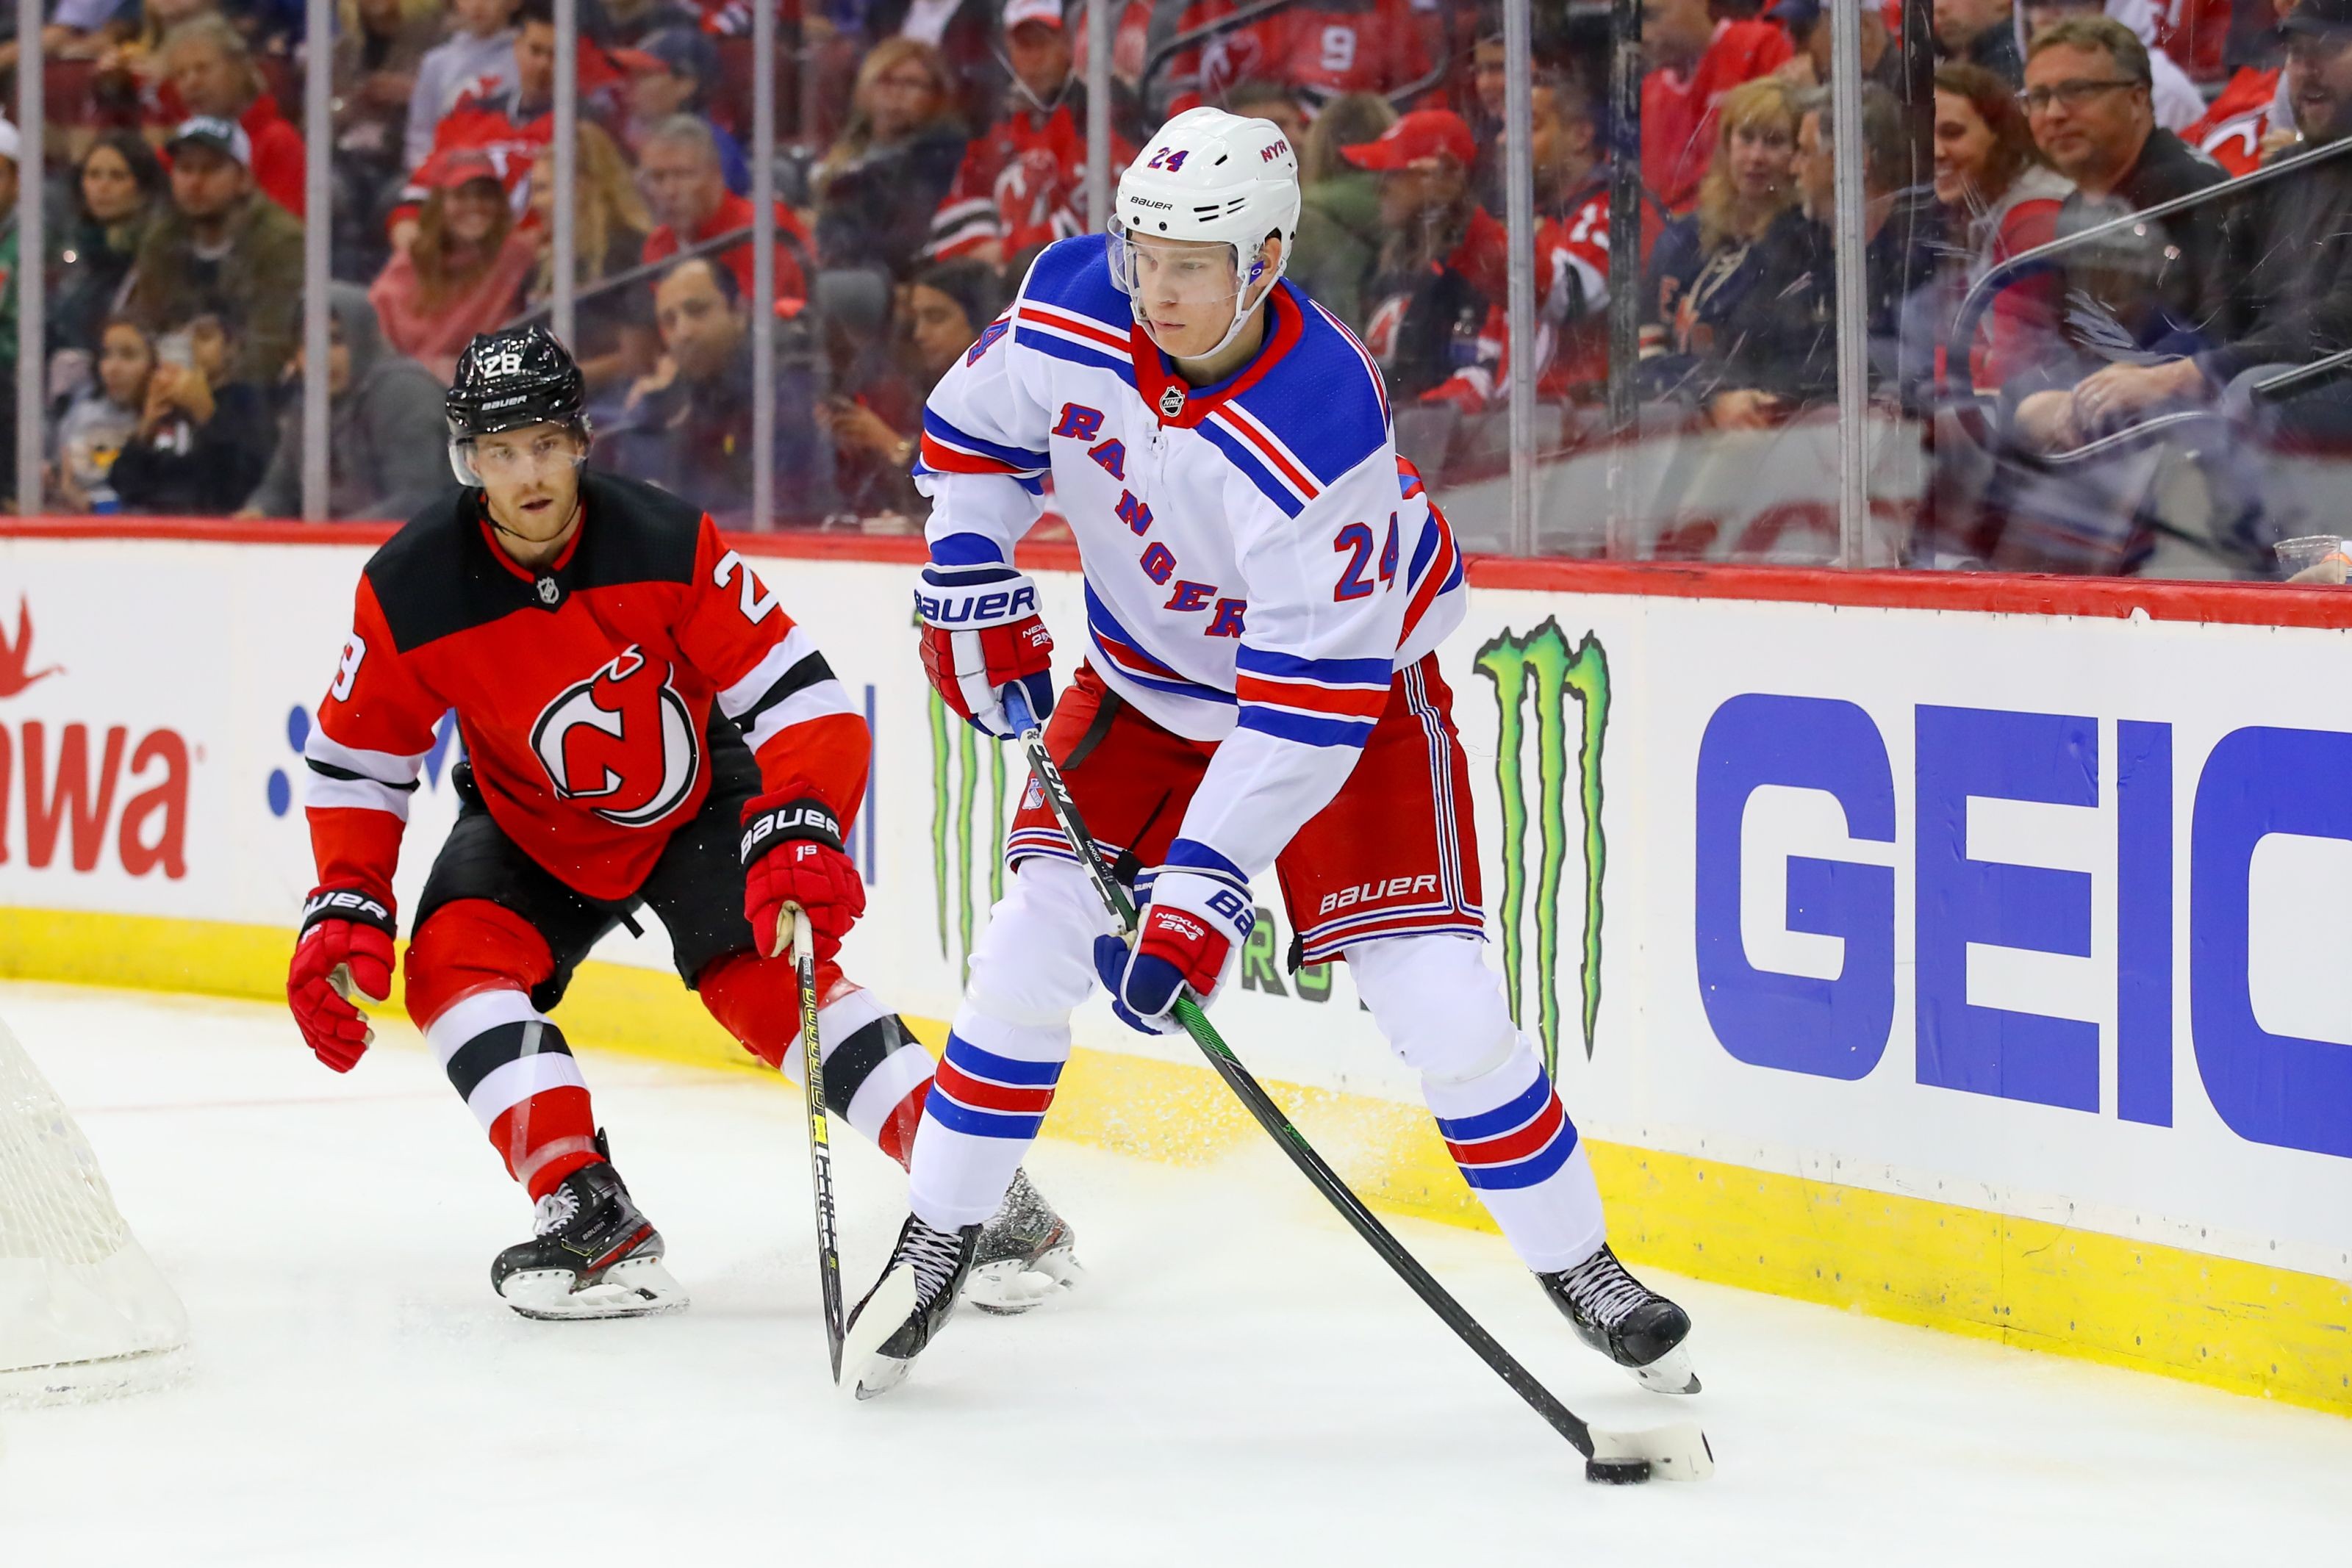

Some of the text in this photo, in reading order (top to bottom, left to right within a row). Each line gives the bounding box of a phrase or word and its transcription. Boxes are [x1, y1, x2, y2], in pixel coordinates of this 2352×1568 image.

[1321, 26, 1355, 71] 9
[1147, 147, 1189, 173] 24
[1261, 140, 1288, 163] NYR
[1130, 196, 1173, 211] BAUER
[967, 301, 1016, 367] 4
[484, 353, 521, 379] 28
[481, 395, 528, 411] BAUER
[1052, 402, 1247, 639] RANGER
[1334, 511, 1399, 602] 24
[713, 549, 779, 625] 2
[0, 719, 190, 880] wa
[741, 808, 841, 865] BAUER
[1086, 840, 1101, 863] KAKKO
[302, 892, 388, 921] UER
[1319, 874, 1436, 916] BAUER
[1155, 913, 1205, 937] NEXUS
[1696, 692, 2352, 1159] GEIC
